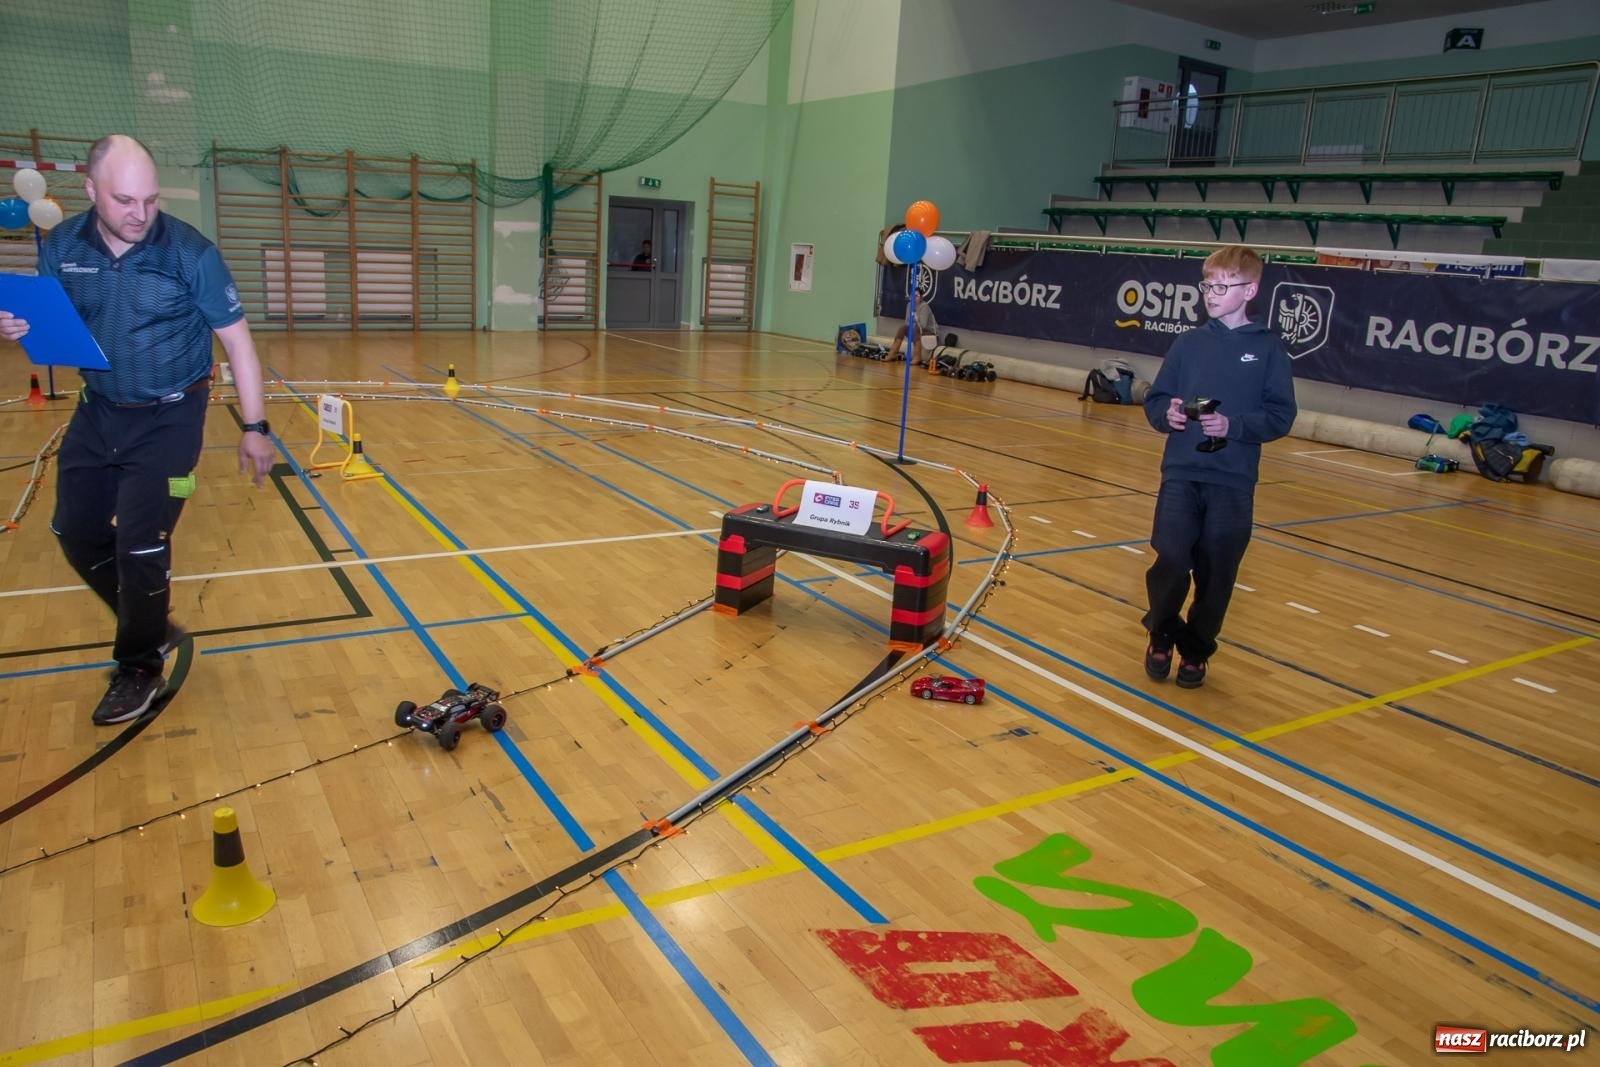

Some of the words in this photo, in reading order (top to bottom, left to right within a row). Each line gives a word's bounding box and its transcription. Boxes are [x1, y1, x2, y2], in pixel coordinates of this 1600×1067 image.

[1456, 35, 1477, 47] A
[953, 274, 1063, 309] RACIBÓRZ
[1116, 280, 1199, 322] OSiR
[1366, 316, 1600, 373] RACIBÓRZ
[809, 514, 828, 522] Grupa
[829, 518, 850, 526] Rybnik
